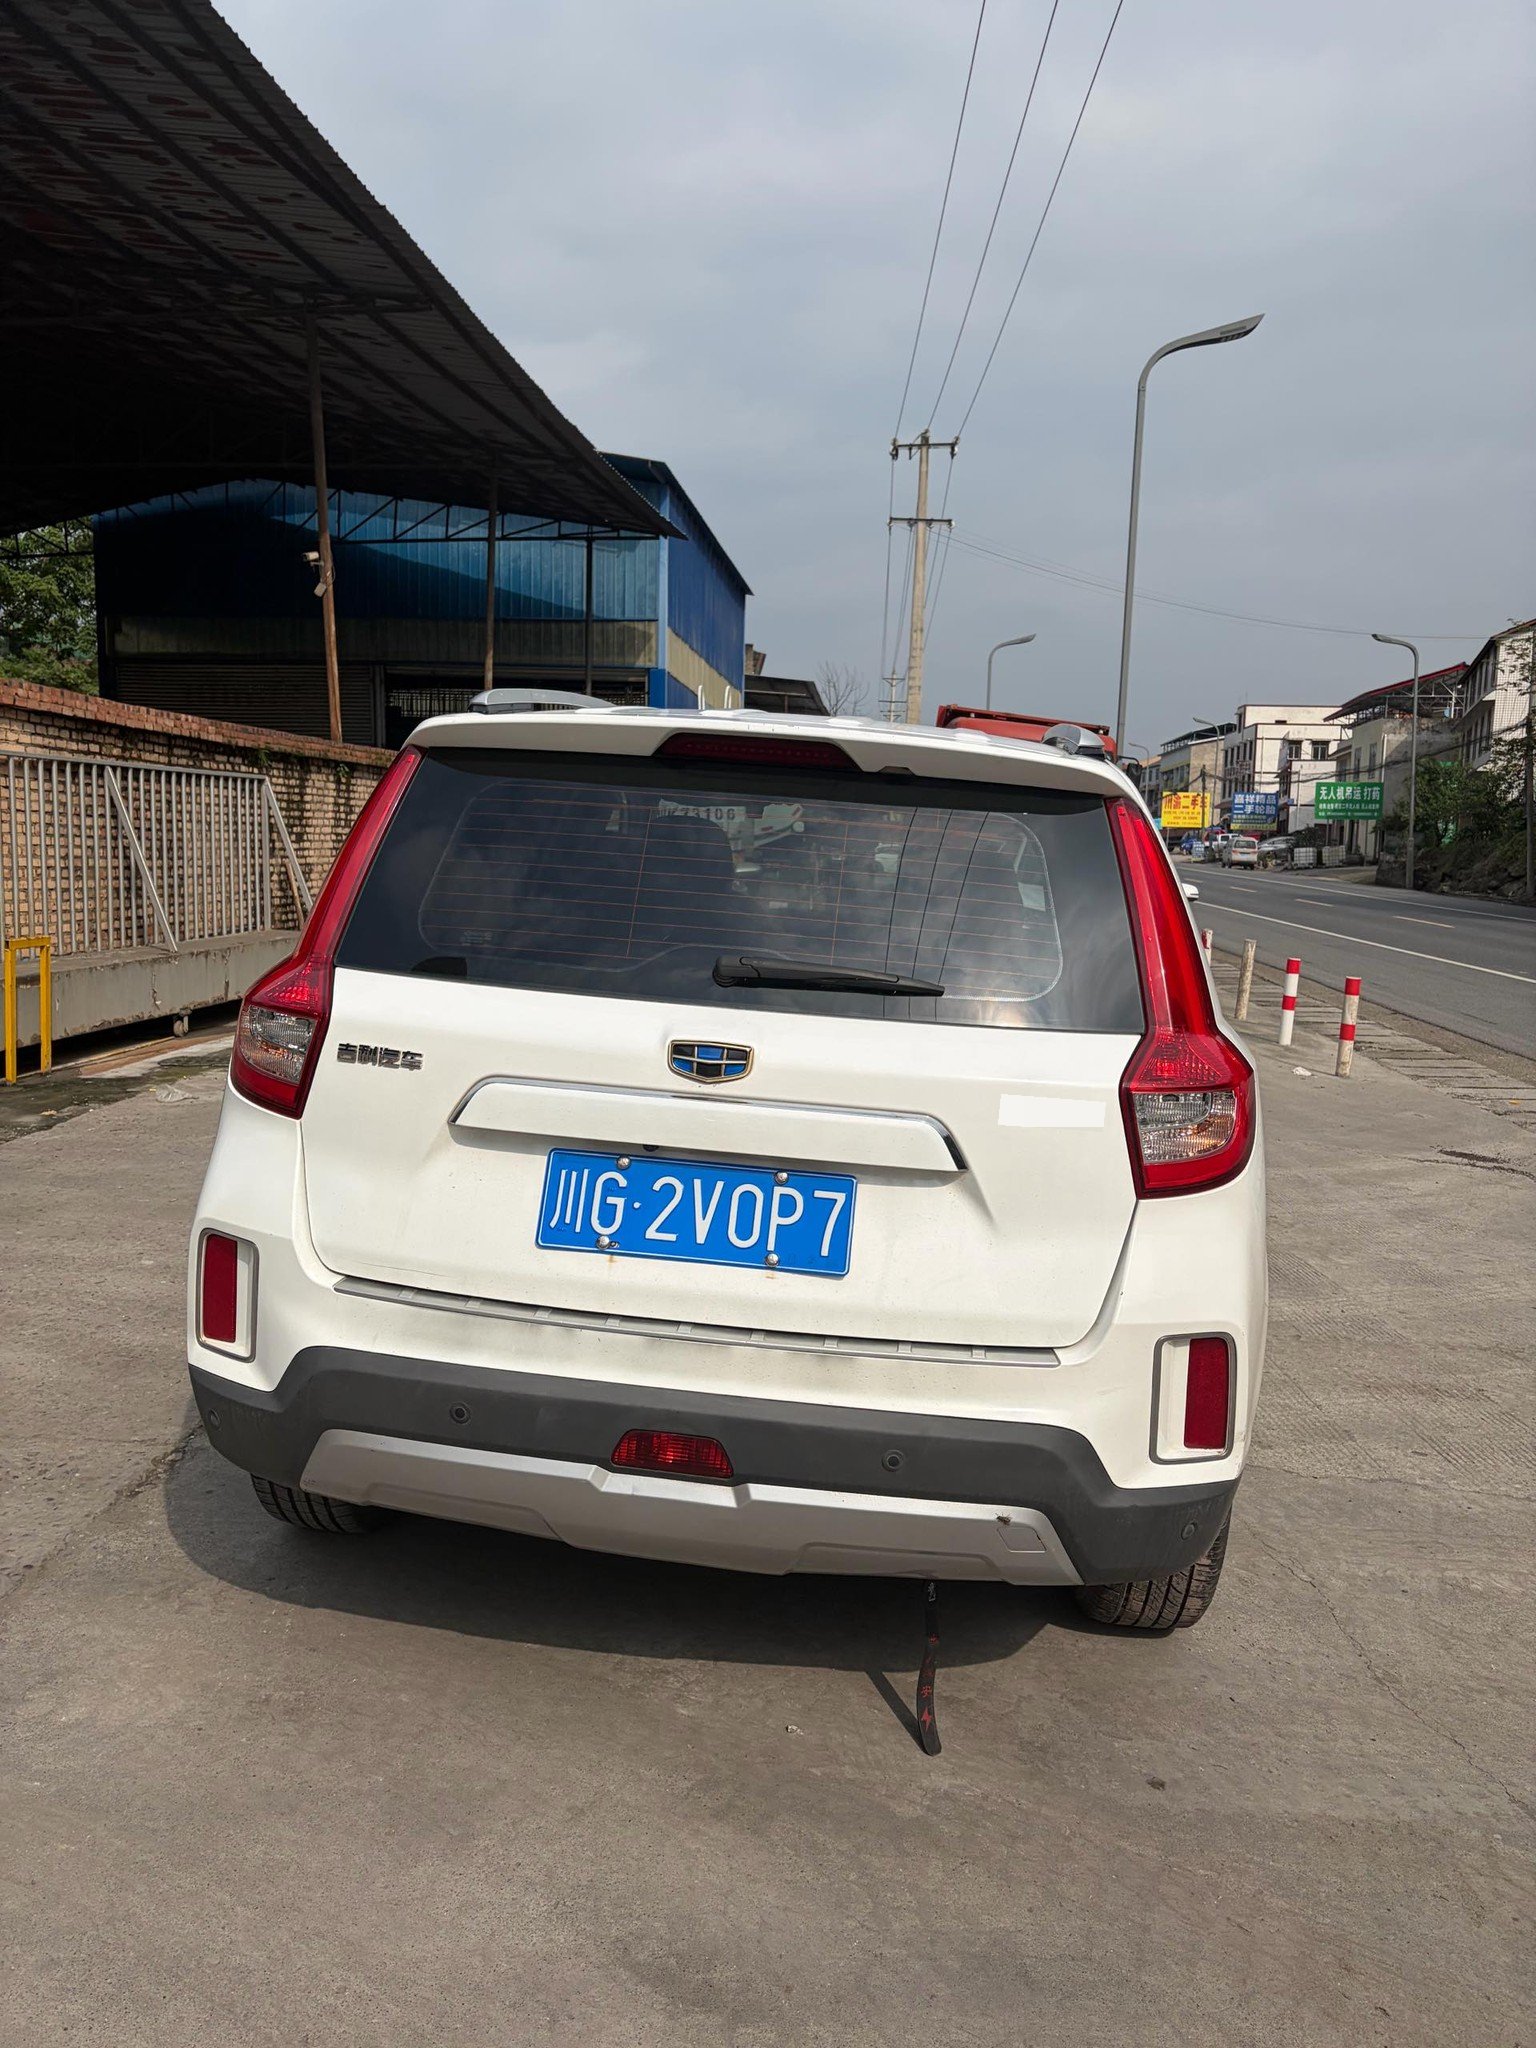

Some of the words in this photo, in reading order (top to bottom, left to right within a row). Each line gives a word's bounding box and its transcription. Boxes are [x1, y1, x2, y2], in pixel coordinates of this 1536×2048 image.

[1233, 804, 1276, 814] 二手轮胎
[337, 1043, 423, 1071] 吉利汽车
